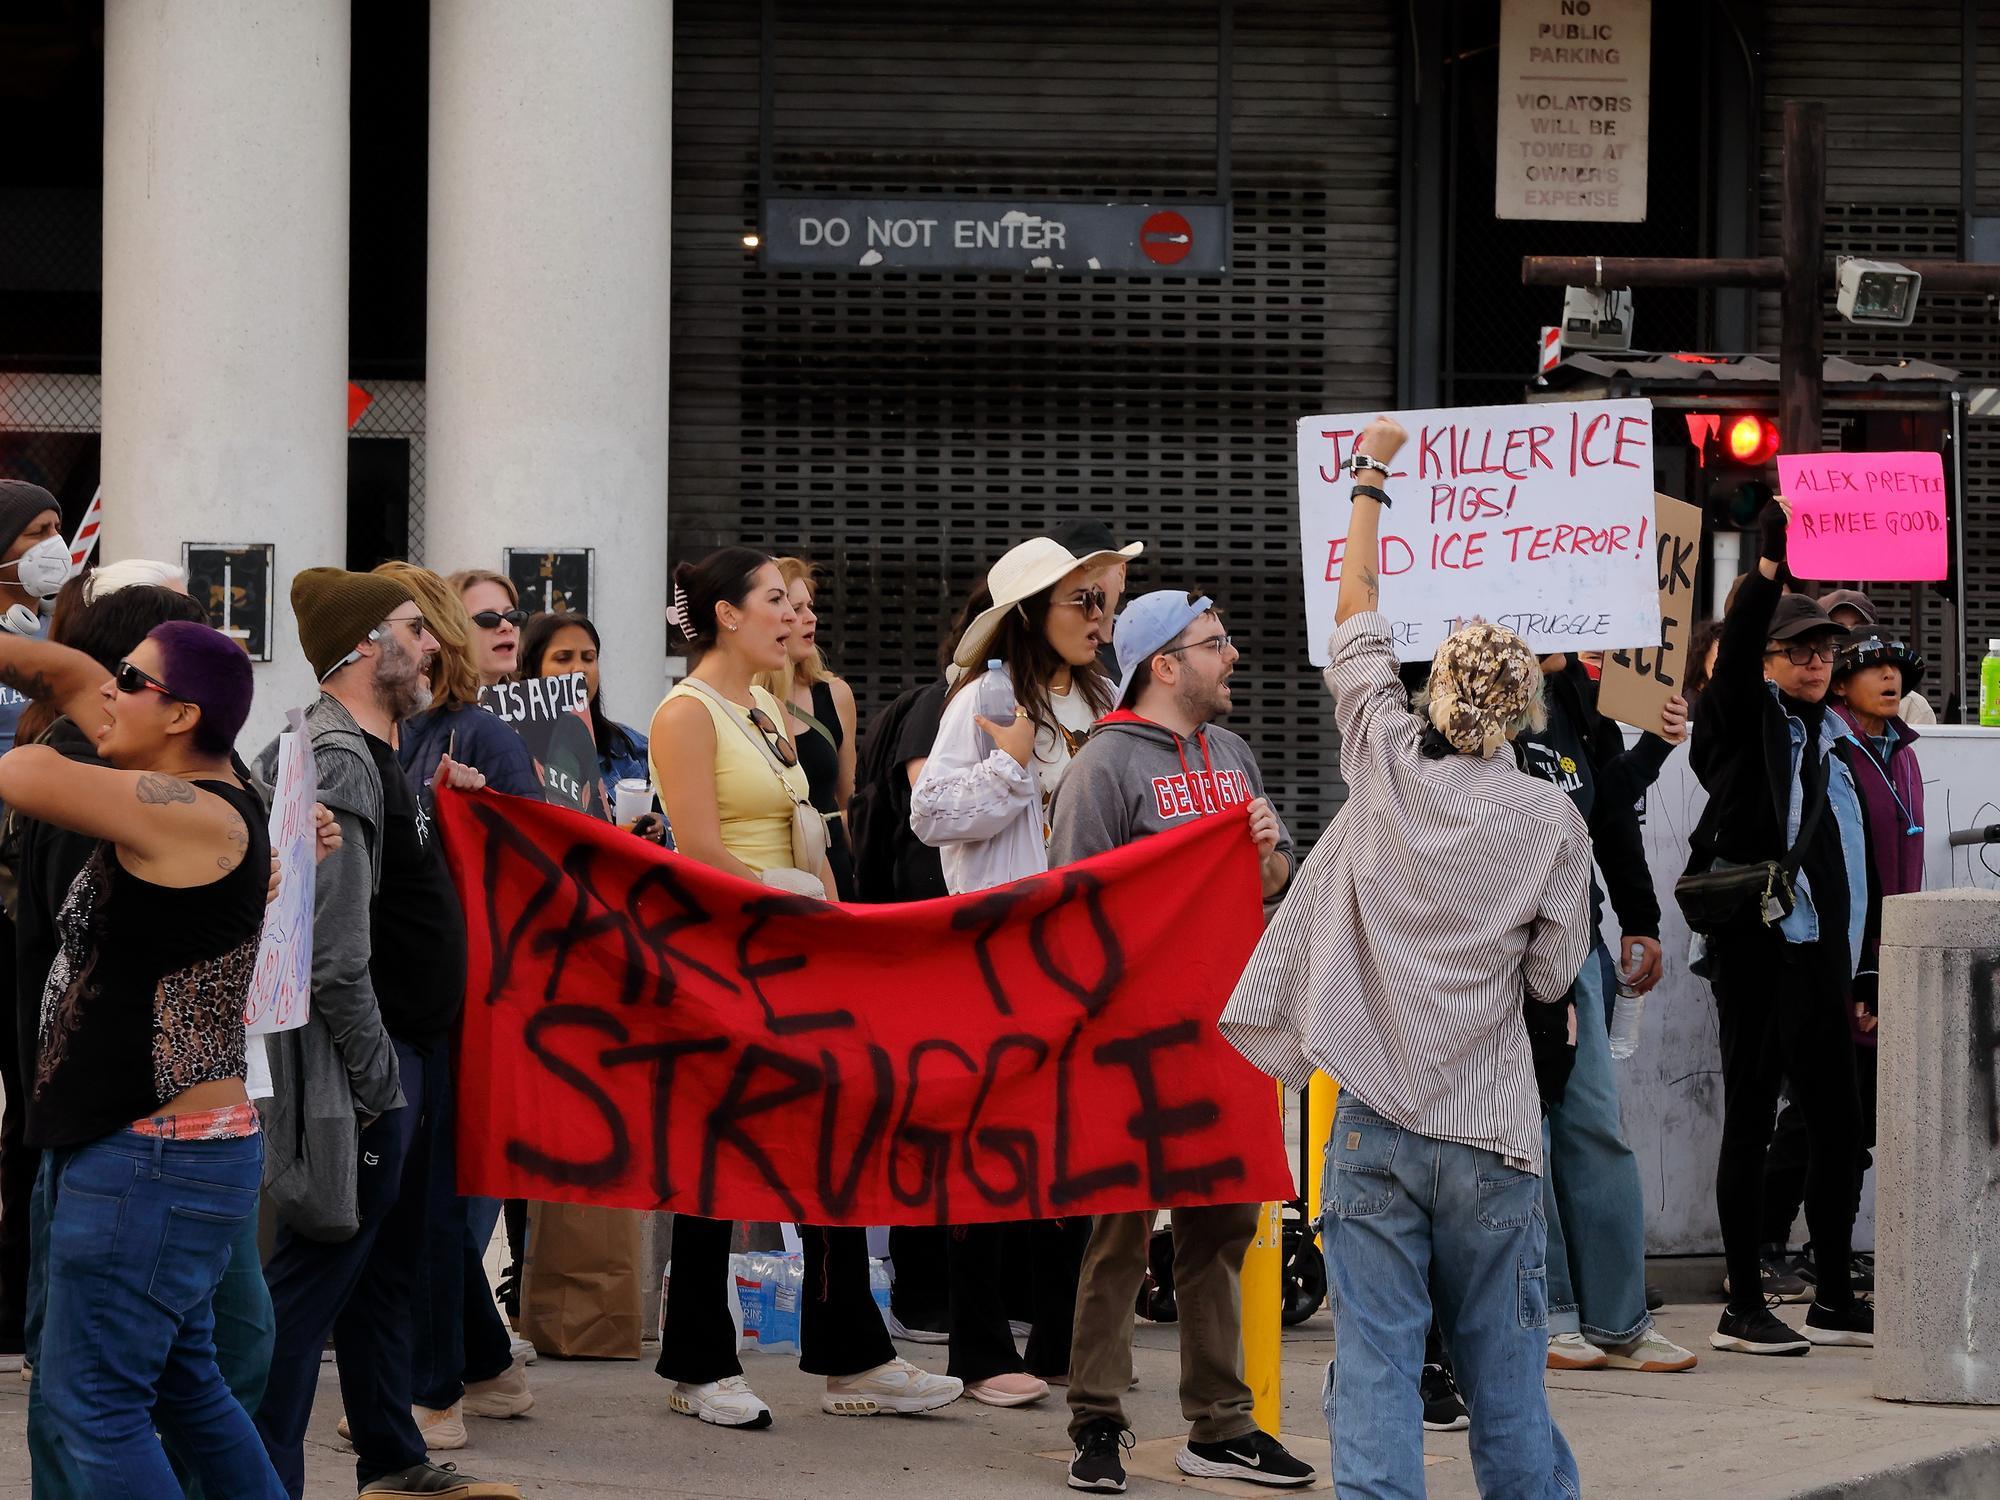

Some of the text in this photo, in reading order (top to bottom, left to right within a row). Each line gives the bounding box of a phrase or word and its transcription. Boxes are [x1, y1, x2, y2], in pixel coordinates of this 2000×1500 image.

[1561, 0, 1591, 16] NO
[1538, 23, 1612, 41] PUBLIC
[1529, 47, 1621, 65] PARKING
[1516, 94, 1632, 112] VIOLATORS
[1530, 118, 1616, 136] WILL BE
[1520, 141, 1629, 160] TOWED AT
[1524, 190, 1620, 208] EXPENSE
[799, 217, 1066, 249] DO NOT ENTER
[1419, 424, 1554, 481] KILLER
[1569, 412, 1649, 477] ICE
[1795, 470, 1857, 492] ALEX
[1431, 484, 1517, 524] PIGS!
[1802, 512, 1877, 538] RENEE
[1325, 516, 1647, 582] ED ICE TERROR!
[1497, 613, 1611, 637] STRUGGLE
[546, 672, 588, 720] PIG
[549, 767, 580, 801] ICE
[1152, 769, 1254, 819] GEORGIA
[470, 803, 855, 1033] DARE
[951, 871, 1123, 1018] TO
[504, 1005, 1247, 1224] STRUGGLE
